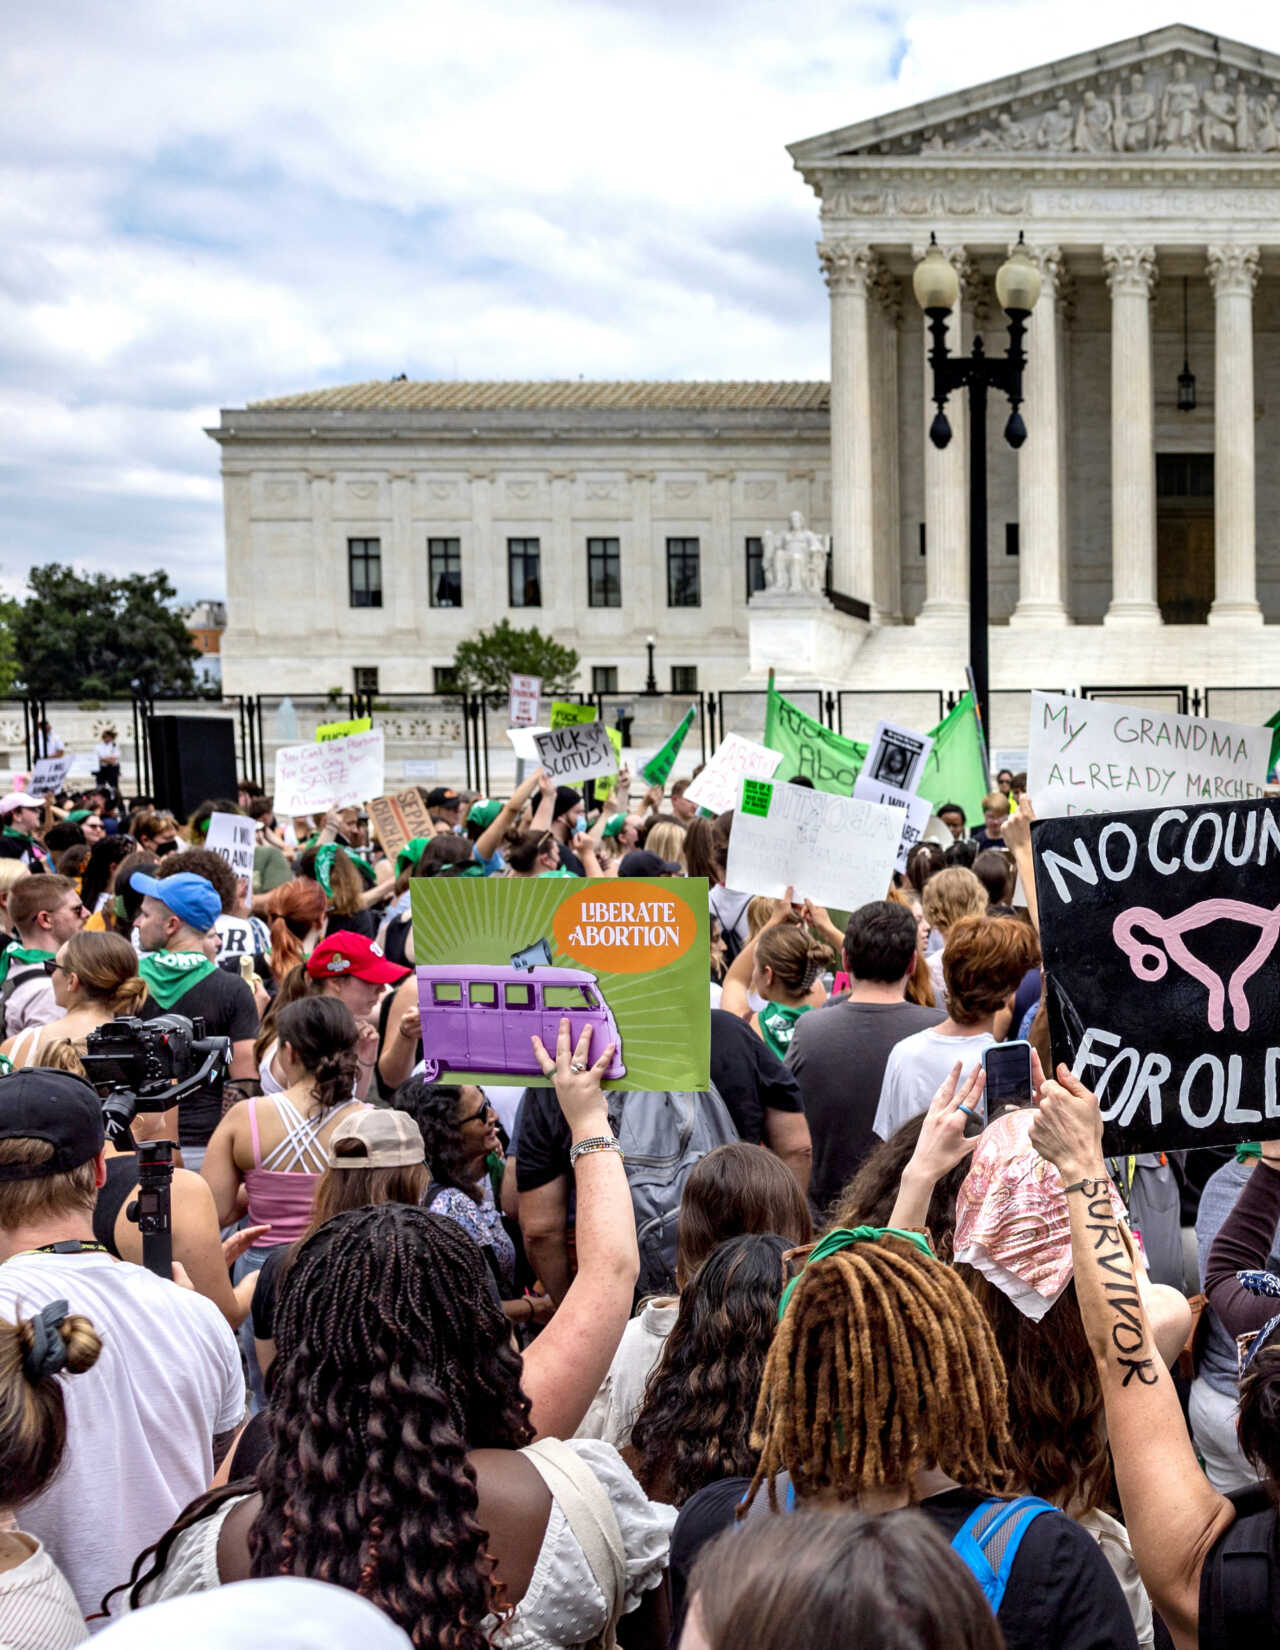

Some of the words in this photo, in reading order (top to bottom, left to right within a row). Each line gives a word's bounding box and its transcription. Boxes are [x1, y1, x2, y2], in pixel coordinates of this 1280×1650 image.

[536, 729, 588, 757] FUCK
[1114, 716, 1248, 763] GRANDMA
[542, 744, 610, 778] SCOTUS!
[1048, 763, 1176, 796] ALREADY
[1186, 773, 1264, 800] MARCHED
[1041, 822, 1137, 903] NO
[580, 901, 676, 923] LIBERATE
[568, 924, 680, 947] ABORTION
[1071, 1028, 1172, 1127] FOR
[1081, 1178, 1159, 1388] SURVIVOR
